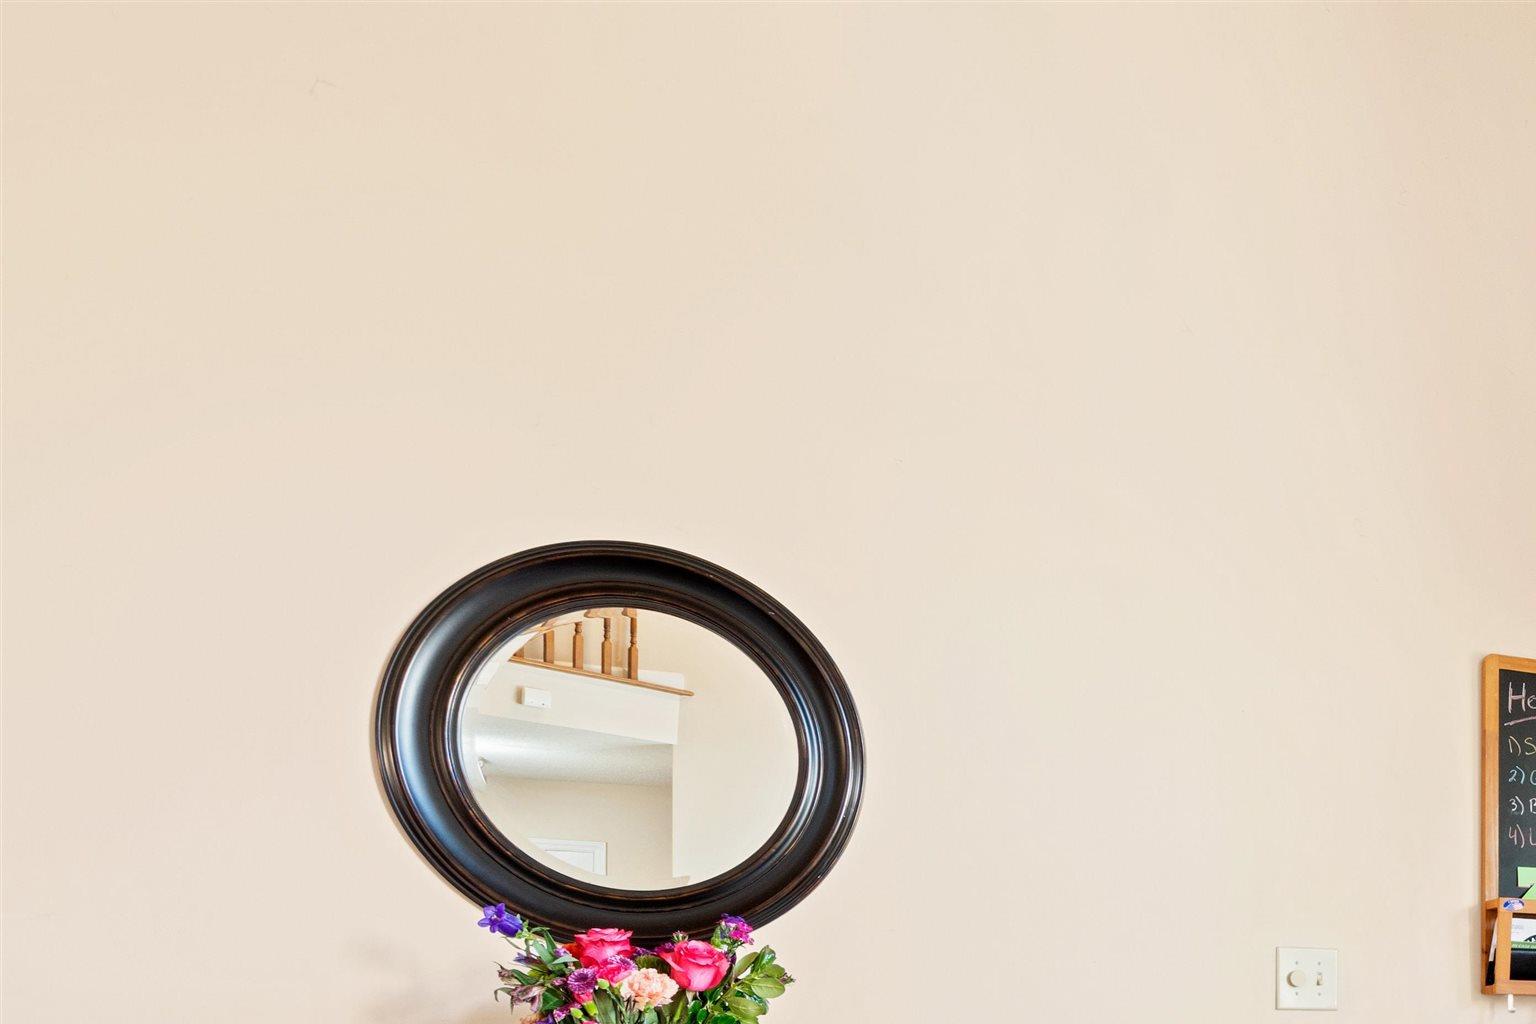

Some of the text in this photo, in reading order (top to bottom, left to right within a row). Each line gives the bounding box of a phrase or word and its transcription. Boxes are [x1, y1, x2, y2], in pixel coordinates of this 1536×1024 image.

[1508, 766, 1525, 785] 2)
[1508, 796, 1525, 815] 3)
[1508, 824, 1525, 848] 4)
